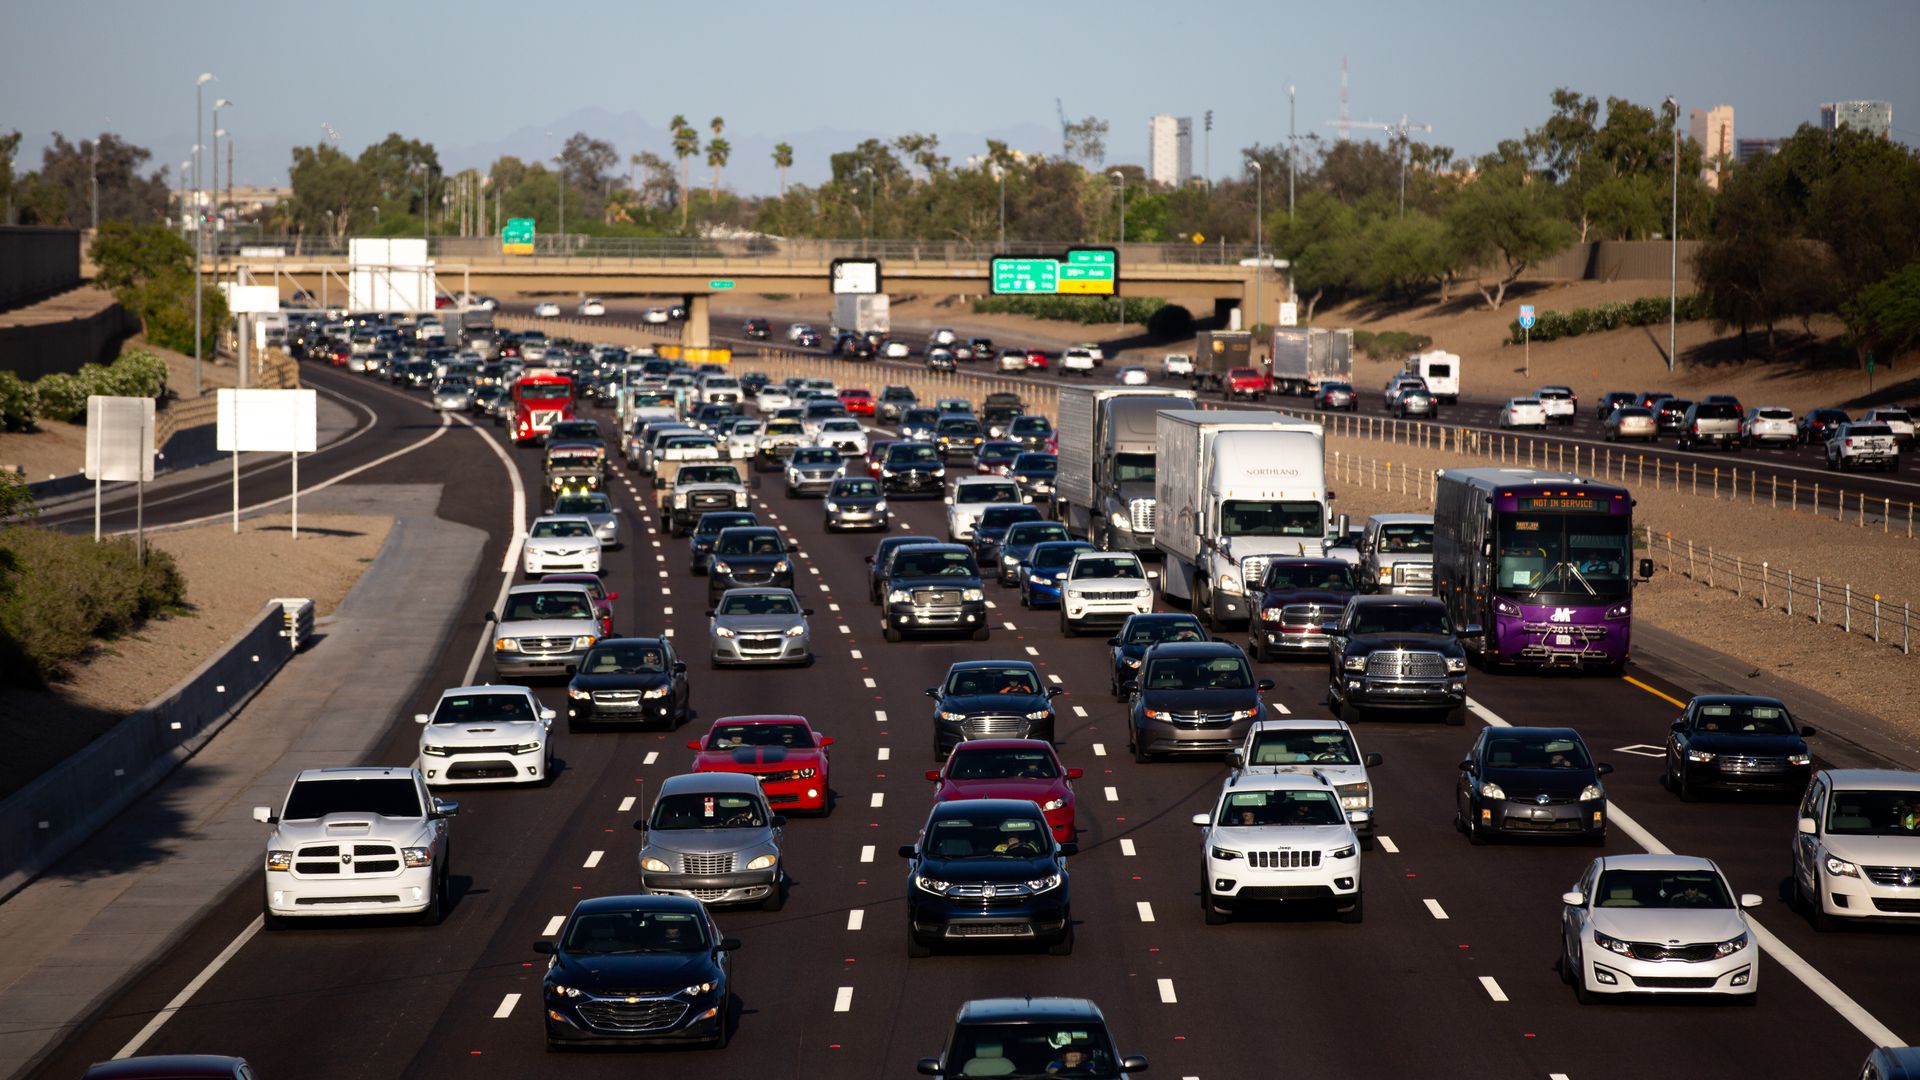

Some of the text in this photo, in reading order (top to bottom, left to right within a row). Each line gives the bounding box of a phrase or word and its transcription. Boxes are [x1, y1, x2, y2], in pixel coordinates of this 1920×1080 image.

[1246, 468, 1299, 476] NORTHLAND
[1533, 499, 1593, 508] NOT IN SERVICE
